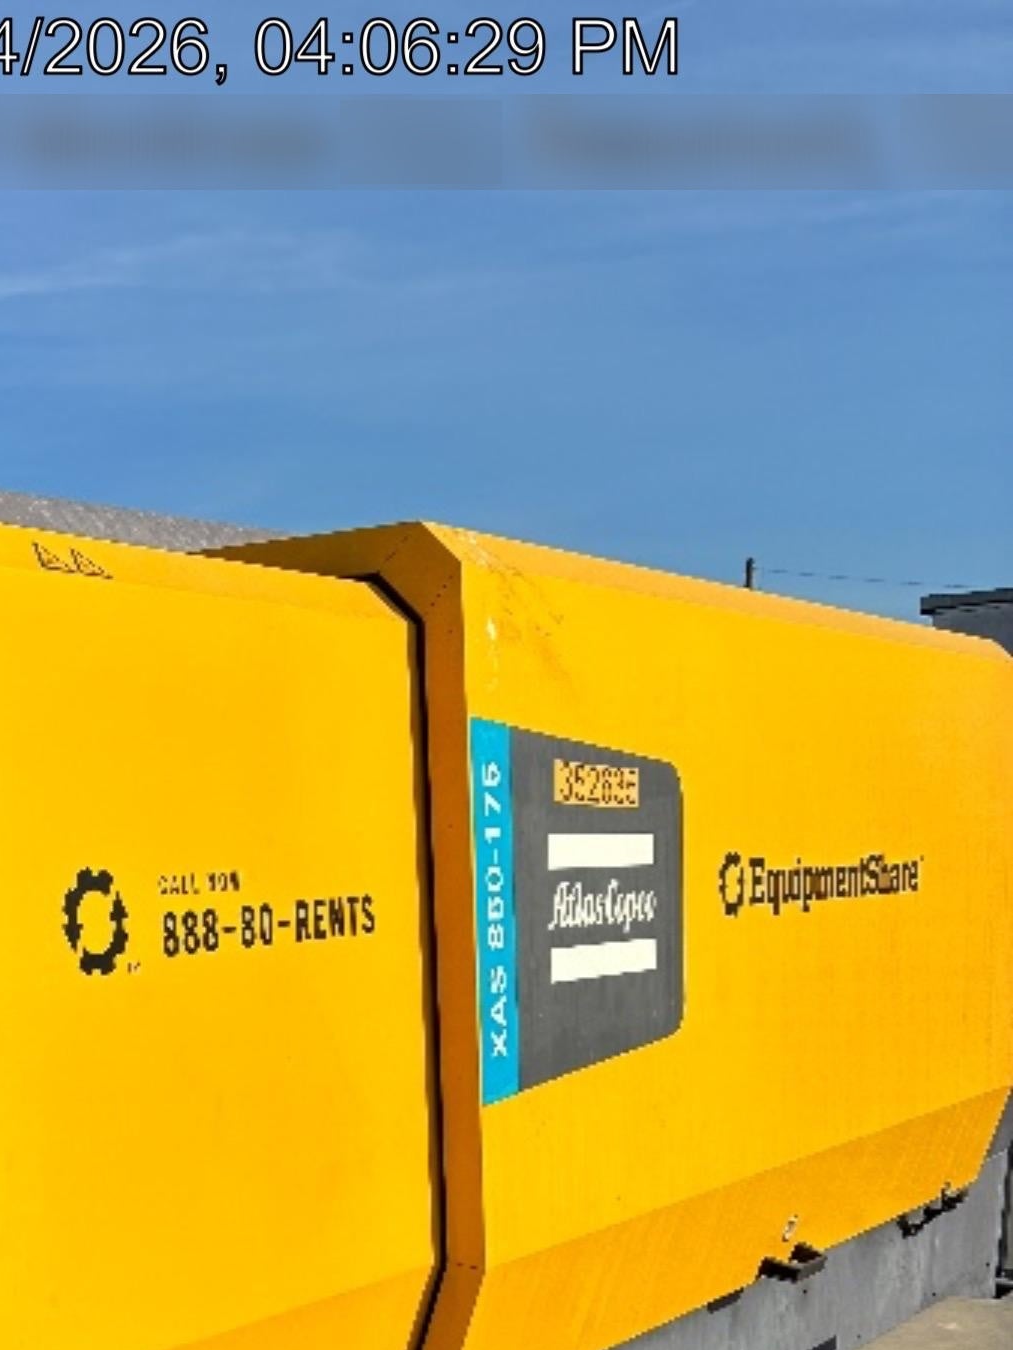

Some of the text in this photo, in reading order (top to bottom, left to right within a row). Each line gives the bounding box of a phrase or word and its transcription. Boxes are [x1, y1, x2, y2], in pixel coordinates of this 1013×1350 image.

[482, 761, 508, 1058] XAS 850-175
[748, 854, 920, 916] EquipmentShare
[162, 893, 376, 959] 888-80-RENTS
